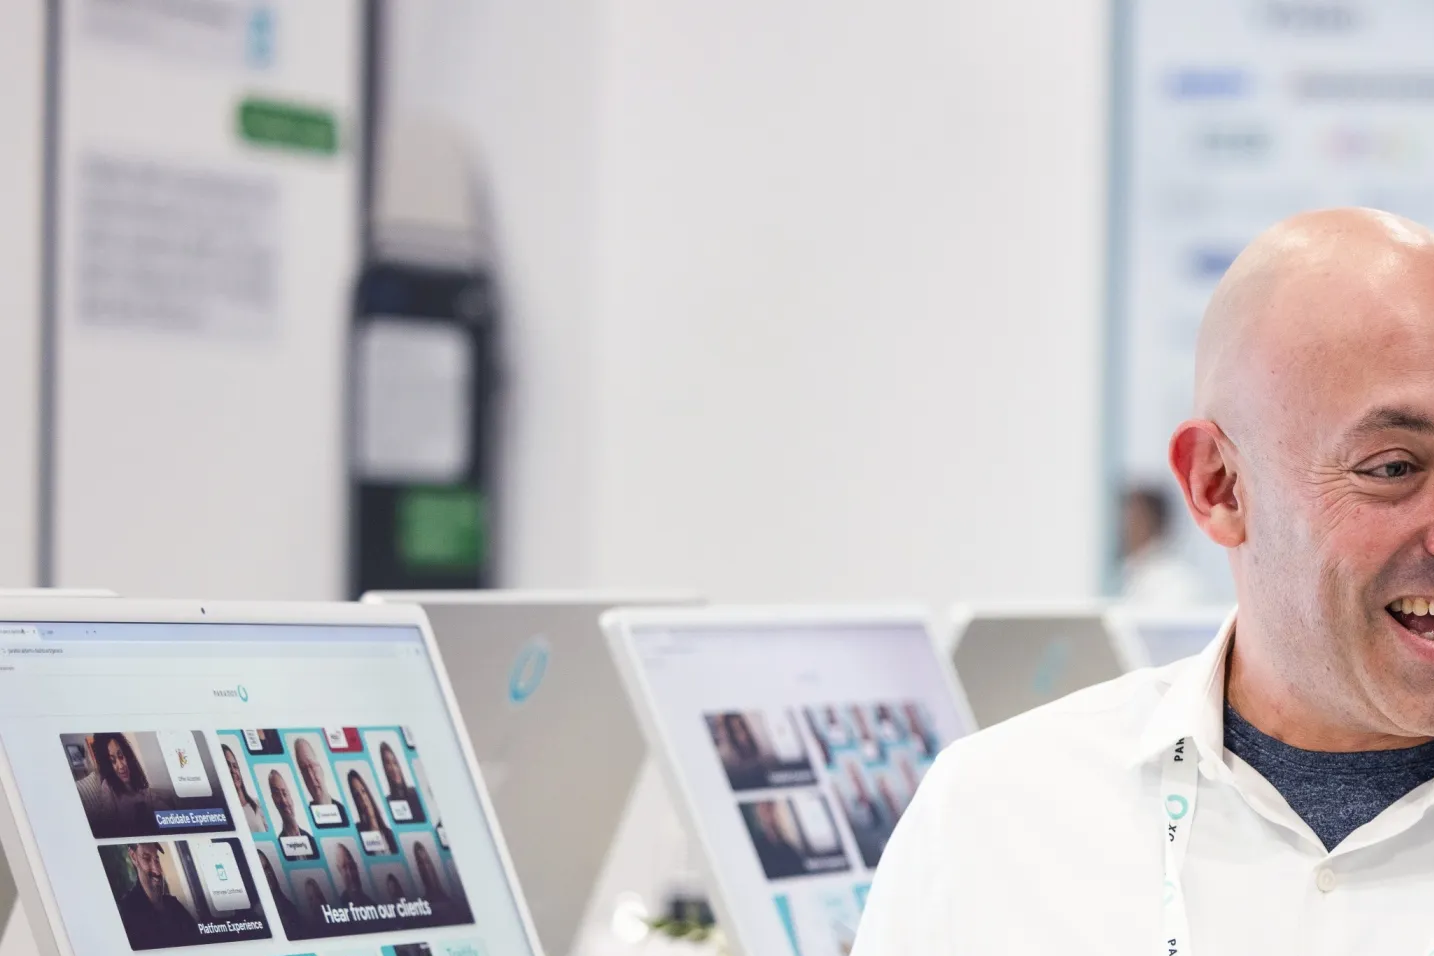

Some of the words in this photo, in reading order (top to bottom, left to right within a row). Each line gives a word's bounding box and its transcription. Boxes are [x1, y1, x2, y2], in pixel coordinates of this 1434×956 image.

[156, 813, 191, 826] Candidate
[191, 810, 227, 826] Experience
[321, 903, 350, 924] Hear
[350, 901, 380, 921] from
[380, 903, 396, 918] our
[396, 897, 432, 917] clients
[198, 921, 228, 935] Platform
[228, 919, 264, 934] Experience
